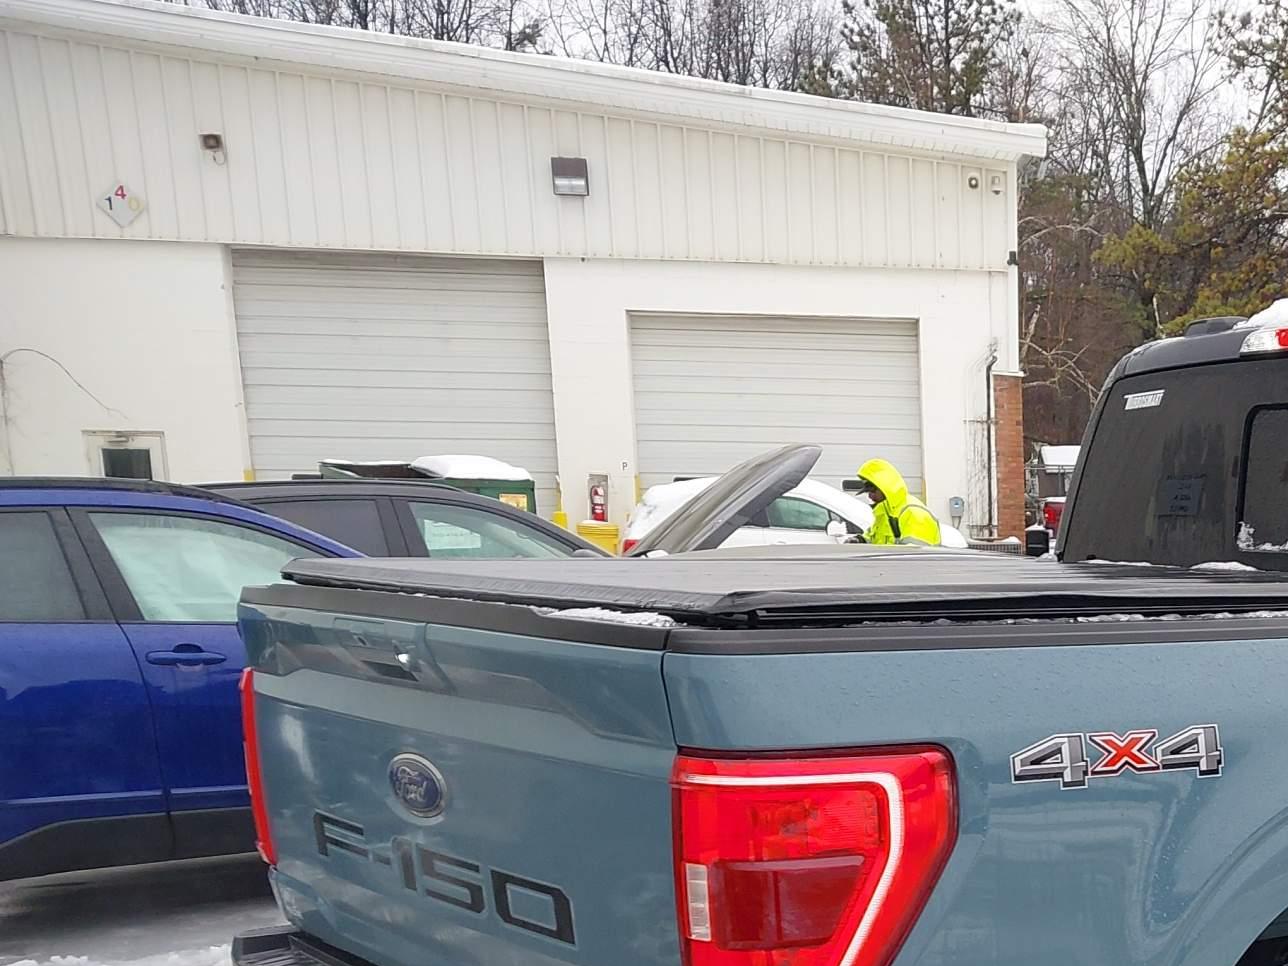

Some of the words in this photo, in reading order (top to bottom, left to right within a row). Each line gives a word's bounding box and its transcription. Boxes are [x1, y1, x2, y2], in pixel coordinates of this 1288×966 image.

[114, 184, 127, 200] 4
[103, 195, 113, 211] 1
[622, 461, 628, 471] P
[313, 811, 576, 945] F-150
